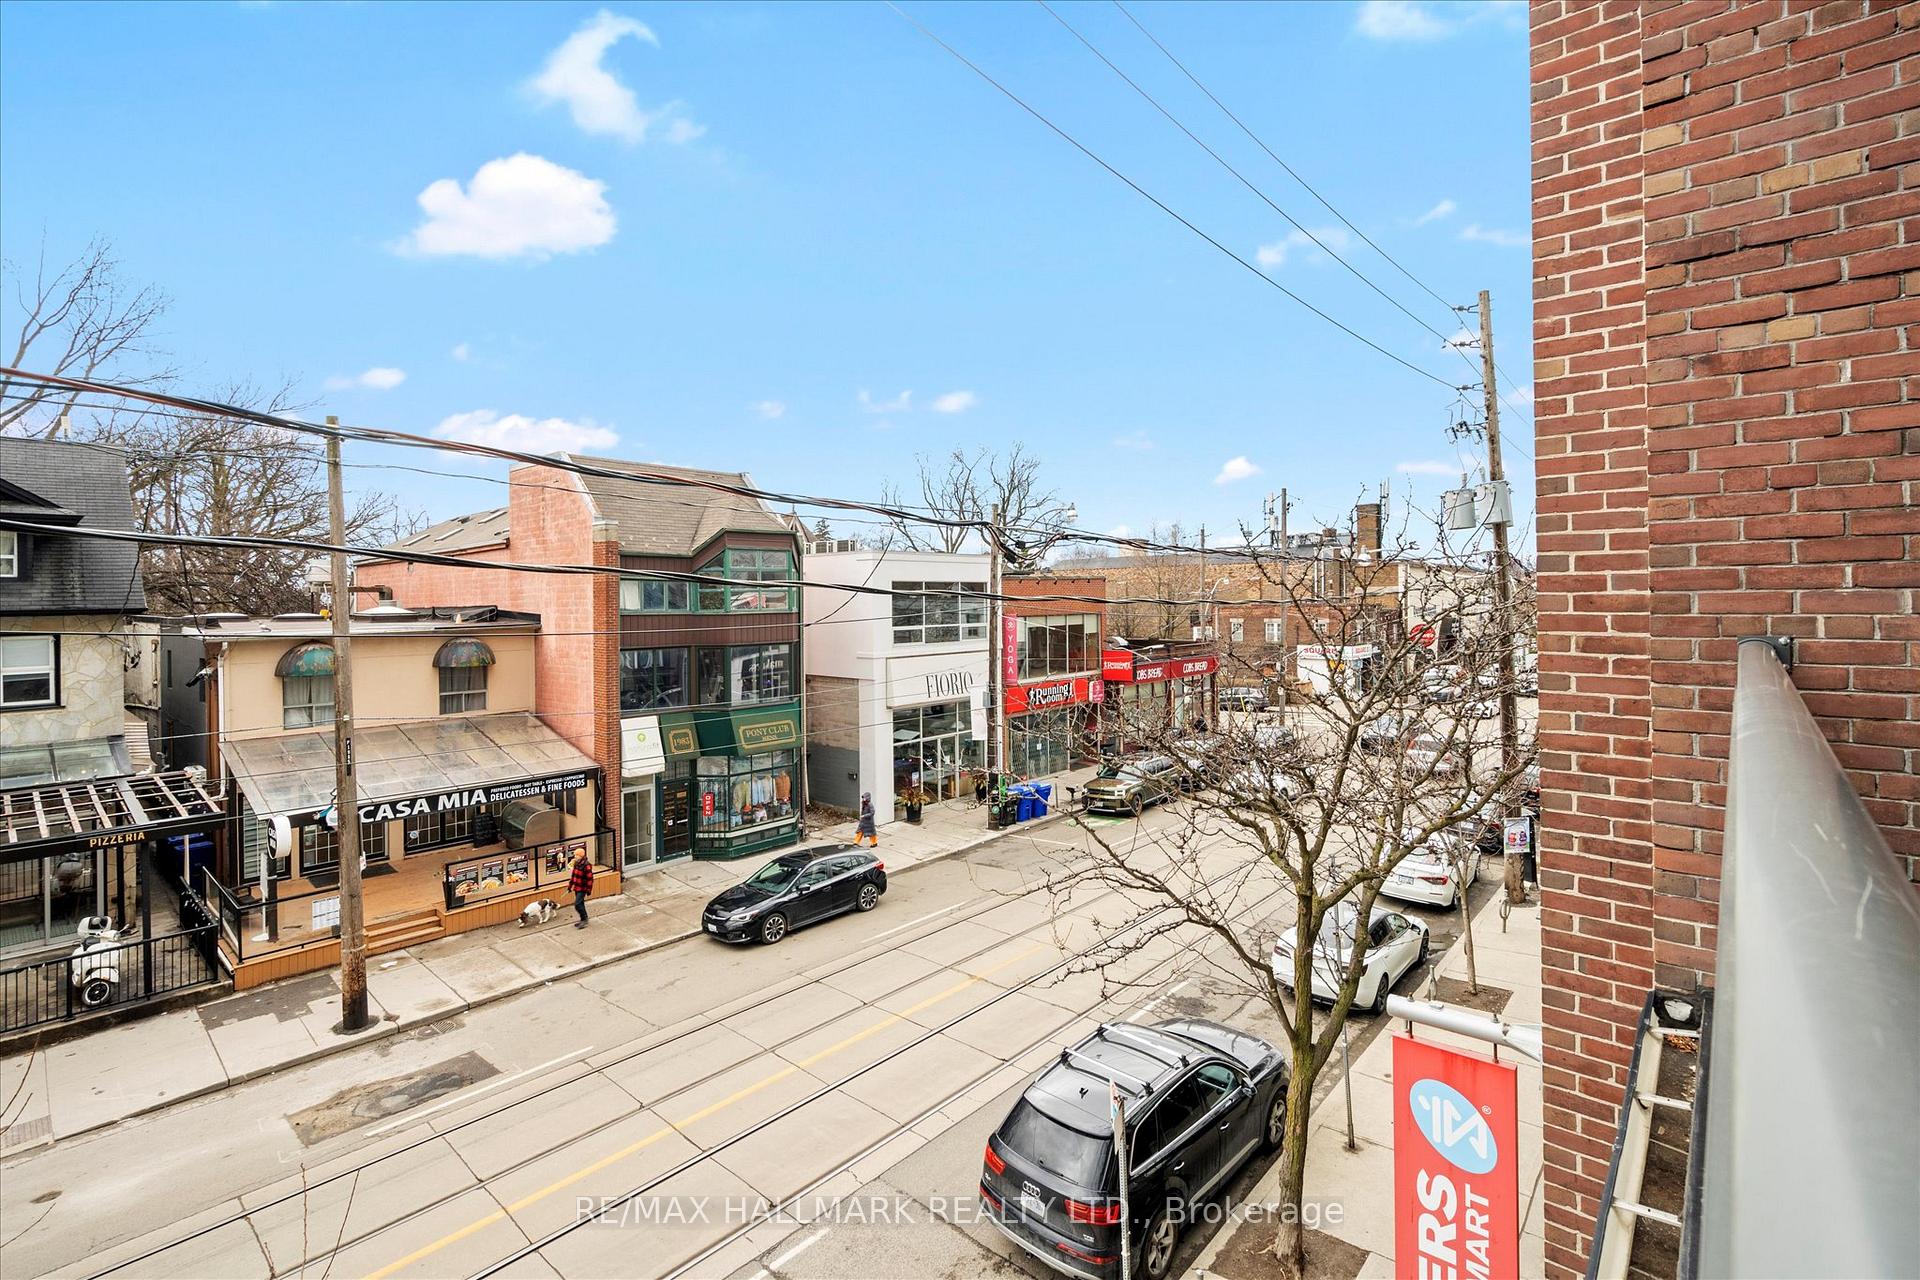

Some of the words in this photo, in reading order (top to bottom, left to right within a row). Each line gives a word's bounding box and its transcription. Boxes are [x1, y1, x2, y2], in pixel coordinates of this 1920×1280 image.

[1006, 635, 1015, 674] YOGA
[926, 671, 973, 699] FIORIO
[746, 728, 767, 738] PONY
[491, 787, 540, 802] DELICATESSEN
[541, 785, 546, 793] &
[548, 781, 562, 792] FINE
[564, 778, 585, 789] FOODS
[360, 798, 430, 823] CASA
[438, 788, 487, 811] MIA
[90, 832, 145, 848] PIZZERIA
